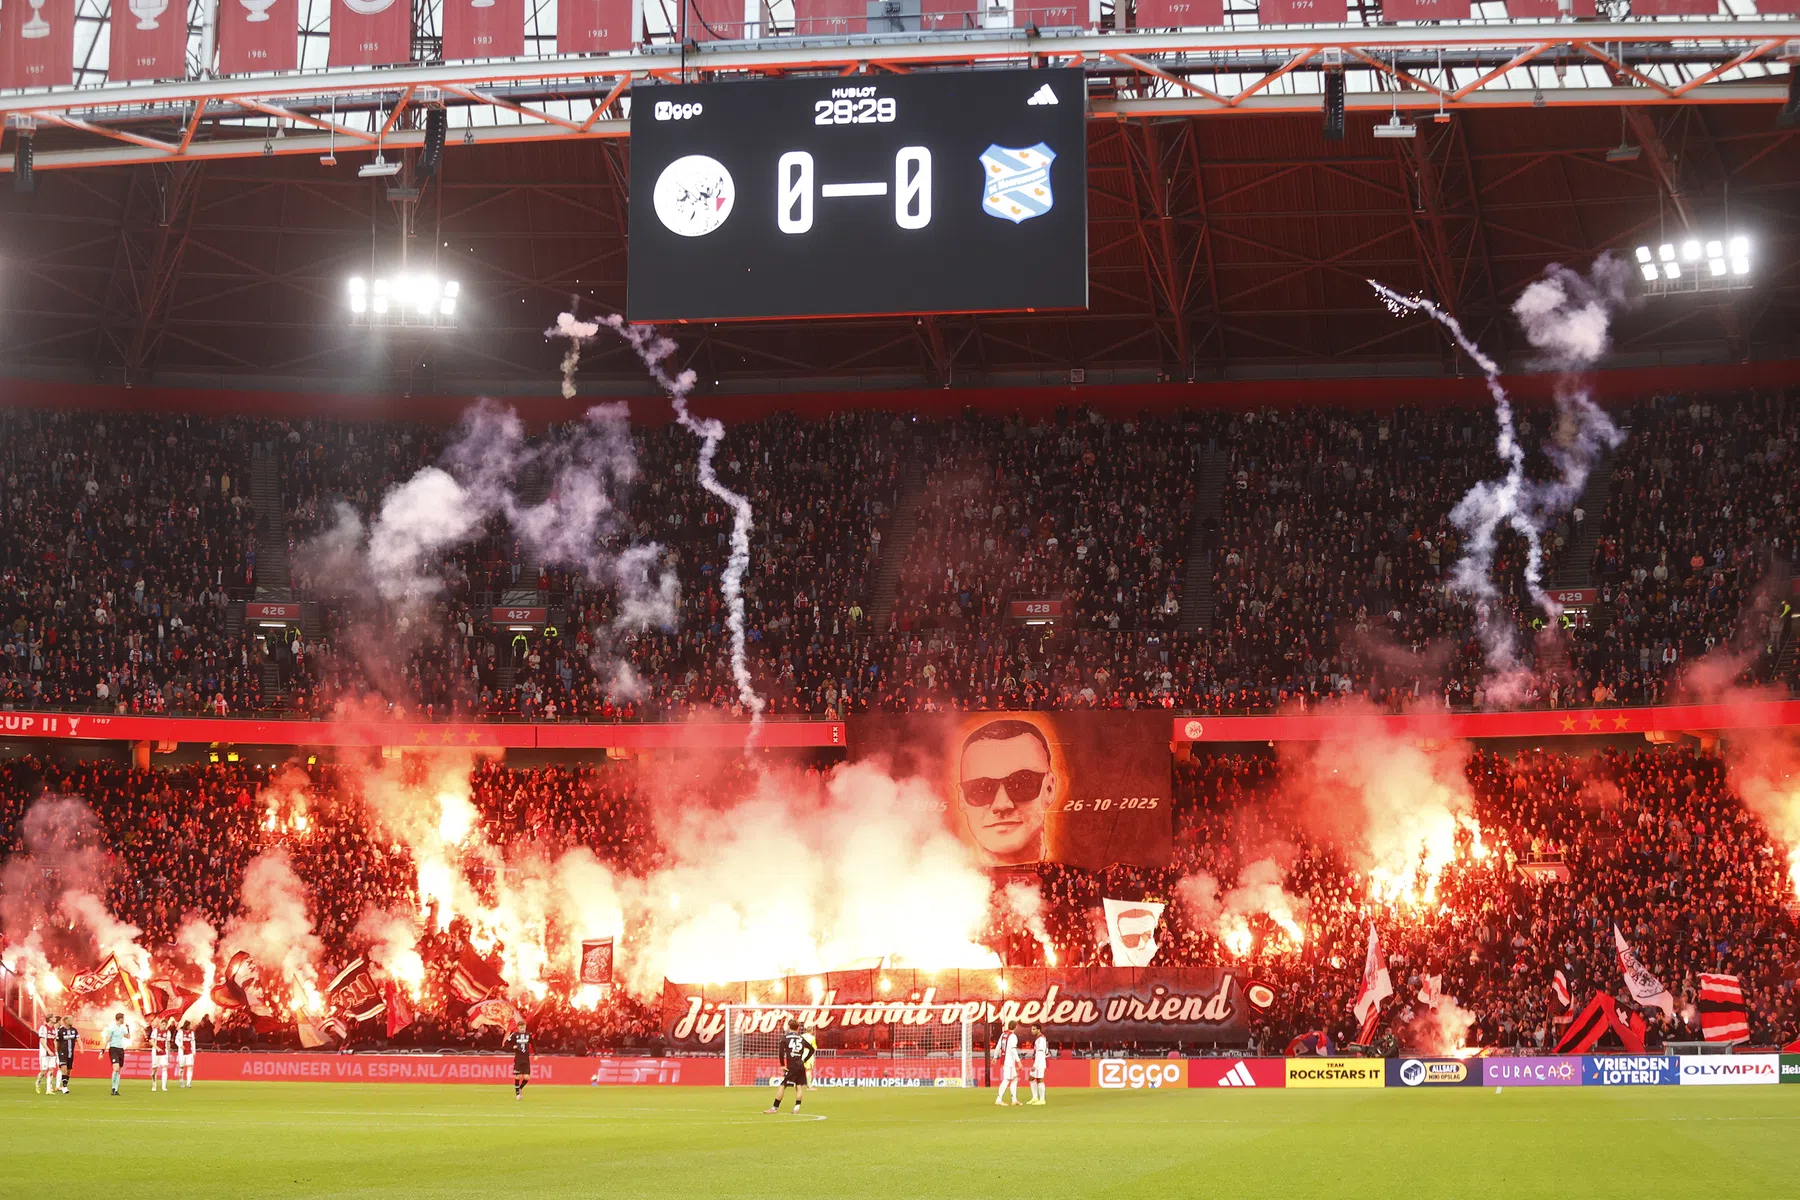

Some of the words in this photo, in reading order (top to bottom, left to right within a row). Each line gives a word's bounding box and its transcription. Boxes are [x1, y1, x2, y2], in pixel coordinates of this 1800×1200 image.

[1168, 4, 1190, 14] 1977
[1291, 1, 1313, 11] 1974
[1045, 9, 1067, 18] 1979
[587, 29, 607, 39] 1983
[472, 36, 493, 46] 1983
[359, 42, 379, 52] 1985
[247, 50, 267, 60] 1986
[137, 57, 156, 67] 1987
[25, 65, 45, 75] 1987
[832, 87, 876, 98] HUBLOT
[815, 98, 896, 125] 29:29
[1558, 593, 1583, 602] 429
[262, 606, 285, 616] 426
[1026, 604, 1050, 613] 428
[508, 610, 531, 620] 427
[43, 717, 57, 732] II
[1063, 798, 1160, 812] 26-10-2025
[674, 995, 728, 1044] Jij
[840, 987, 936, 1027] nooit
[941, 985, 1099, 1035] vergeten
[1106, 974, 1232, 1022] vriend
[788, 1037, 803, 1052] 45
[1432, 1065, 1457, 1073] ALLSAFE
[1593, 1058, 1669, 1071] VRIENDEN
[242, 1061, 331, 1076] ABONNEER
[336, 1063, 364, 1077] VIA
[368, 1063, 552, 1079] ESPN.NL/ABONNEEN
[1290, 1070, 1366, 1079] ROCKSTARS
[1369, 1070, 1380, 1079] IT
[1489, 1064, 1572, 1080] CURAÇAO
[1684, 1065, 1775, 1075] OLYMPIA
[811, 1078, 854, 1087] ALLSAFE
[857, 1078, 878, 1087] MINI
[881, 1078, 920, 1087] OPSLAG
[1603, 1071, 1660, 1085] LOTERIJ
